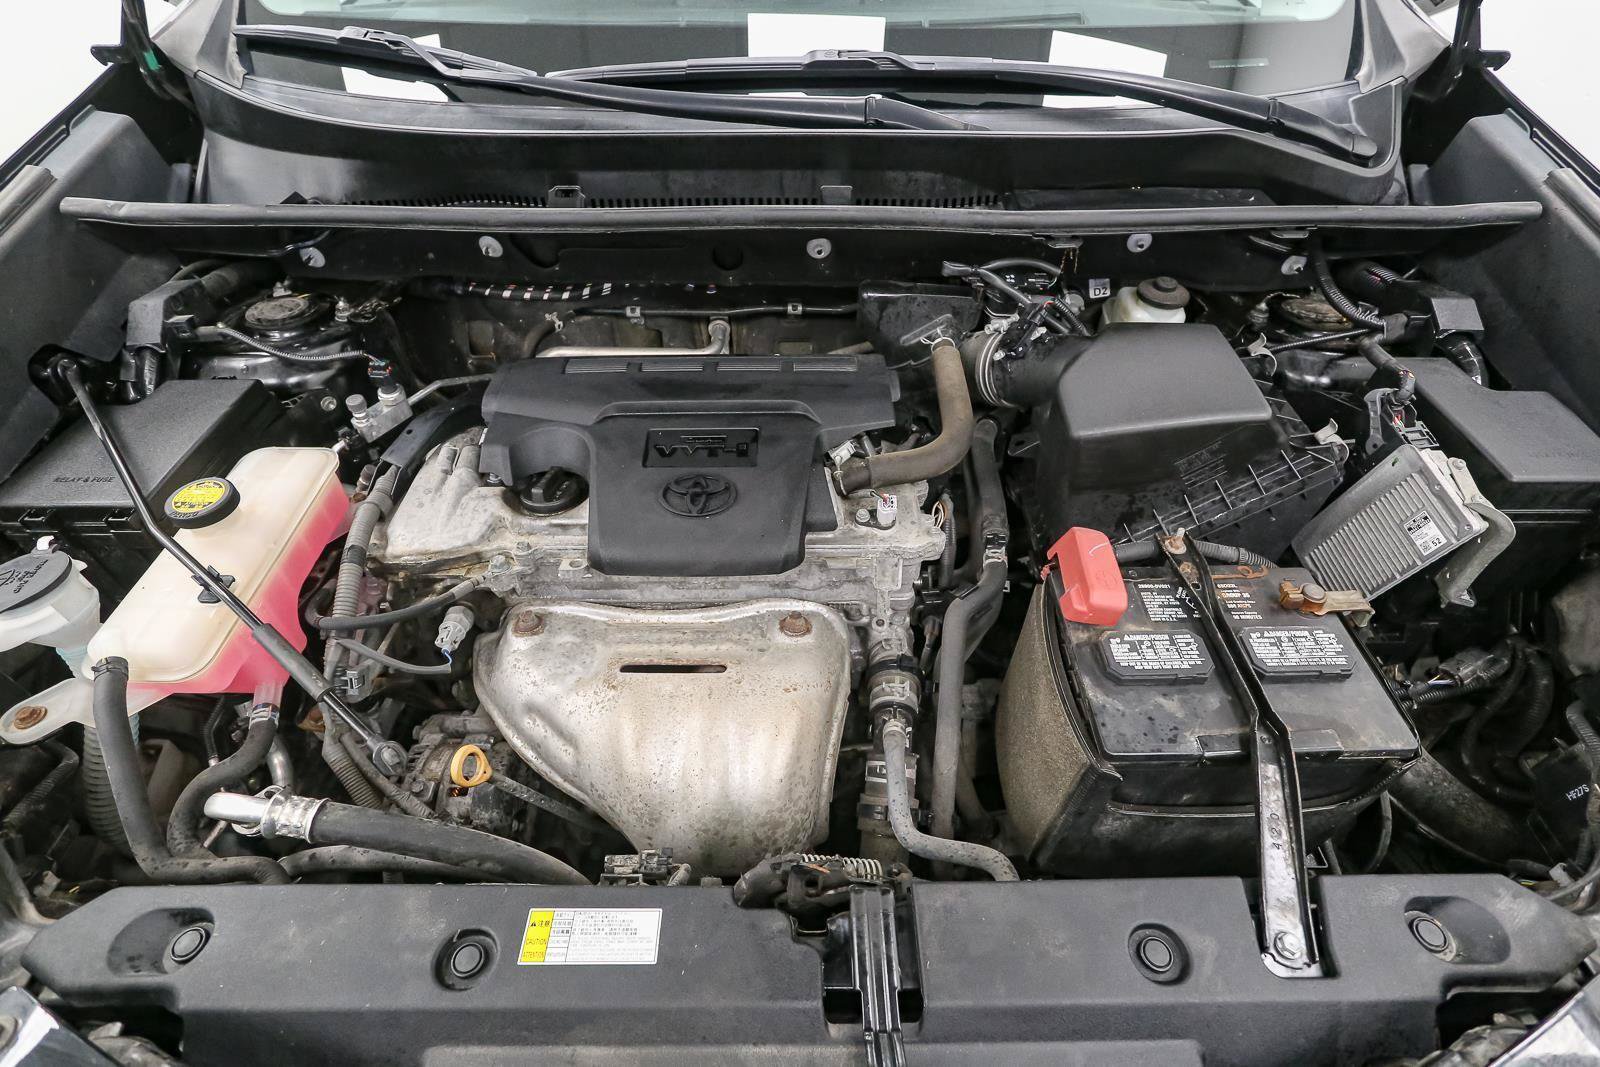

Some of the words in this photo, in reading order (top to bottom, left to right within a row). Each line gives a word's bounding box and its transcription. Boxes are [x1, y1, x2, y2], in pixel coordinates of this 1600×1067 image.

[1093, 287, 1108, 296] D2
[1431, 537, 1442, 547] 52
[1565, 784, 1590, 800] HF27S
